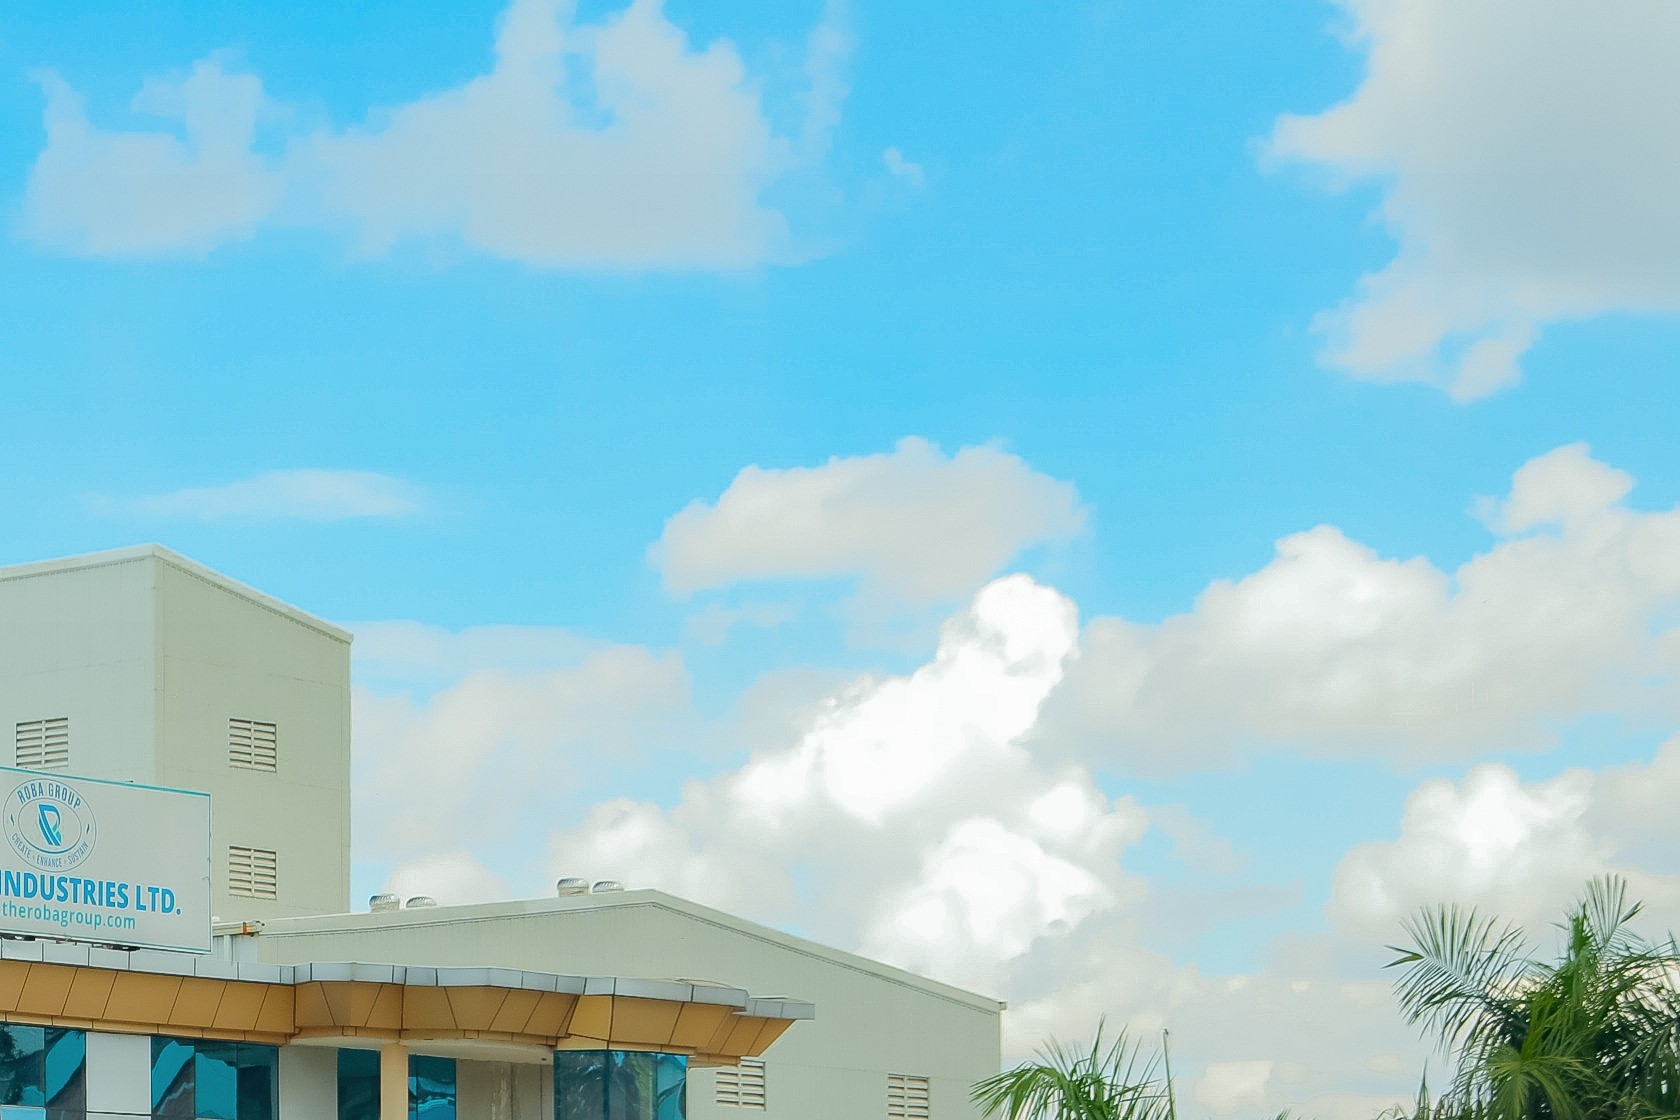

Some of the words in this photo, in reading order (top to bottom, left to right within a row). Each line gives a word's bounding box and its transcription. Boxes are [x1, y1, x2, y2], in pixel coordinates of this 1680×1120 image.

[17, 783, 44, 804] ROBA
[48, 783, 81, 809] GROUP
[11, 833, 31, 859] CREATE
[37, 854, 62, 868] ENHANCE
[68, 841, 89, 865] SUSTAIN
[135, 885, 182, 915] LTD.
